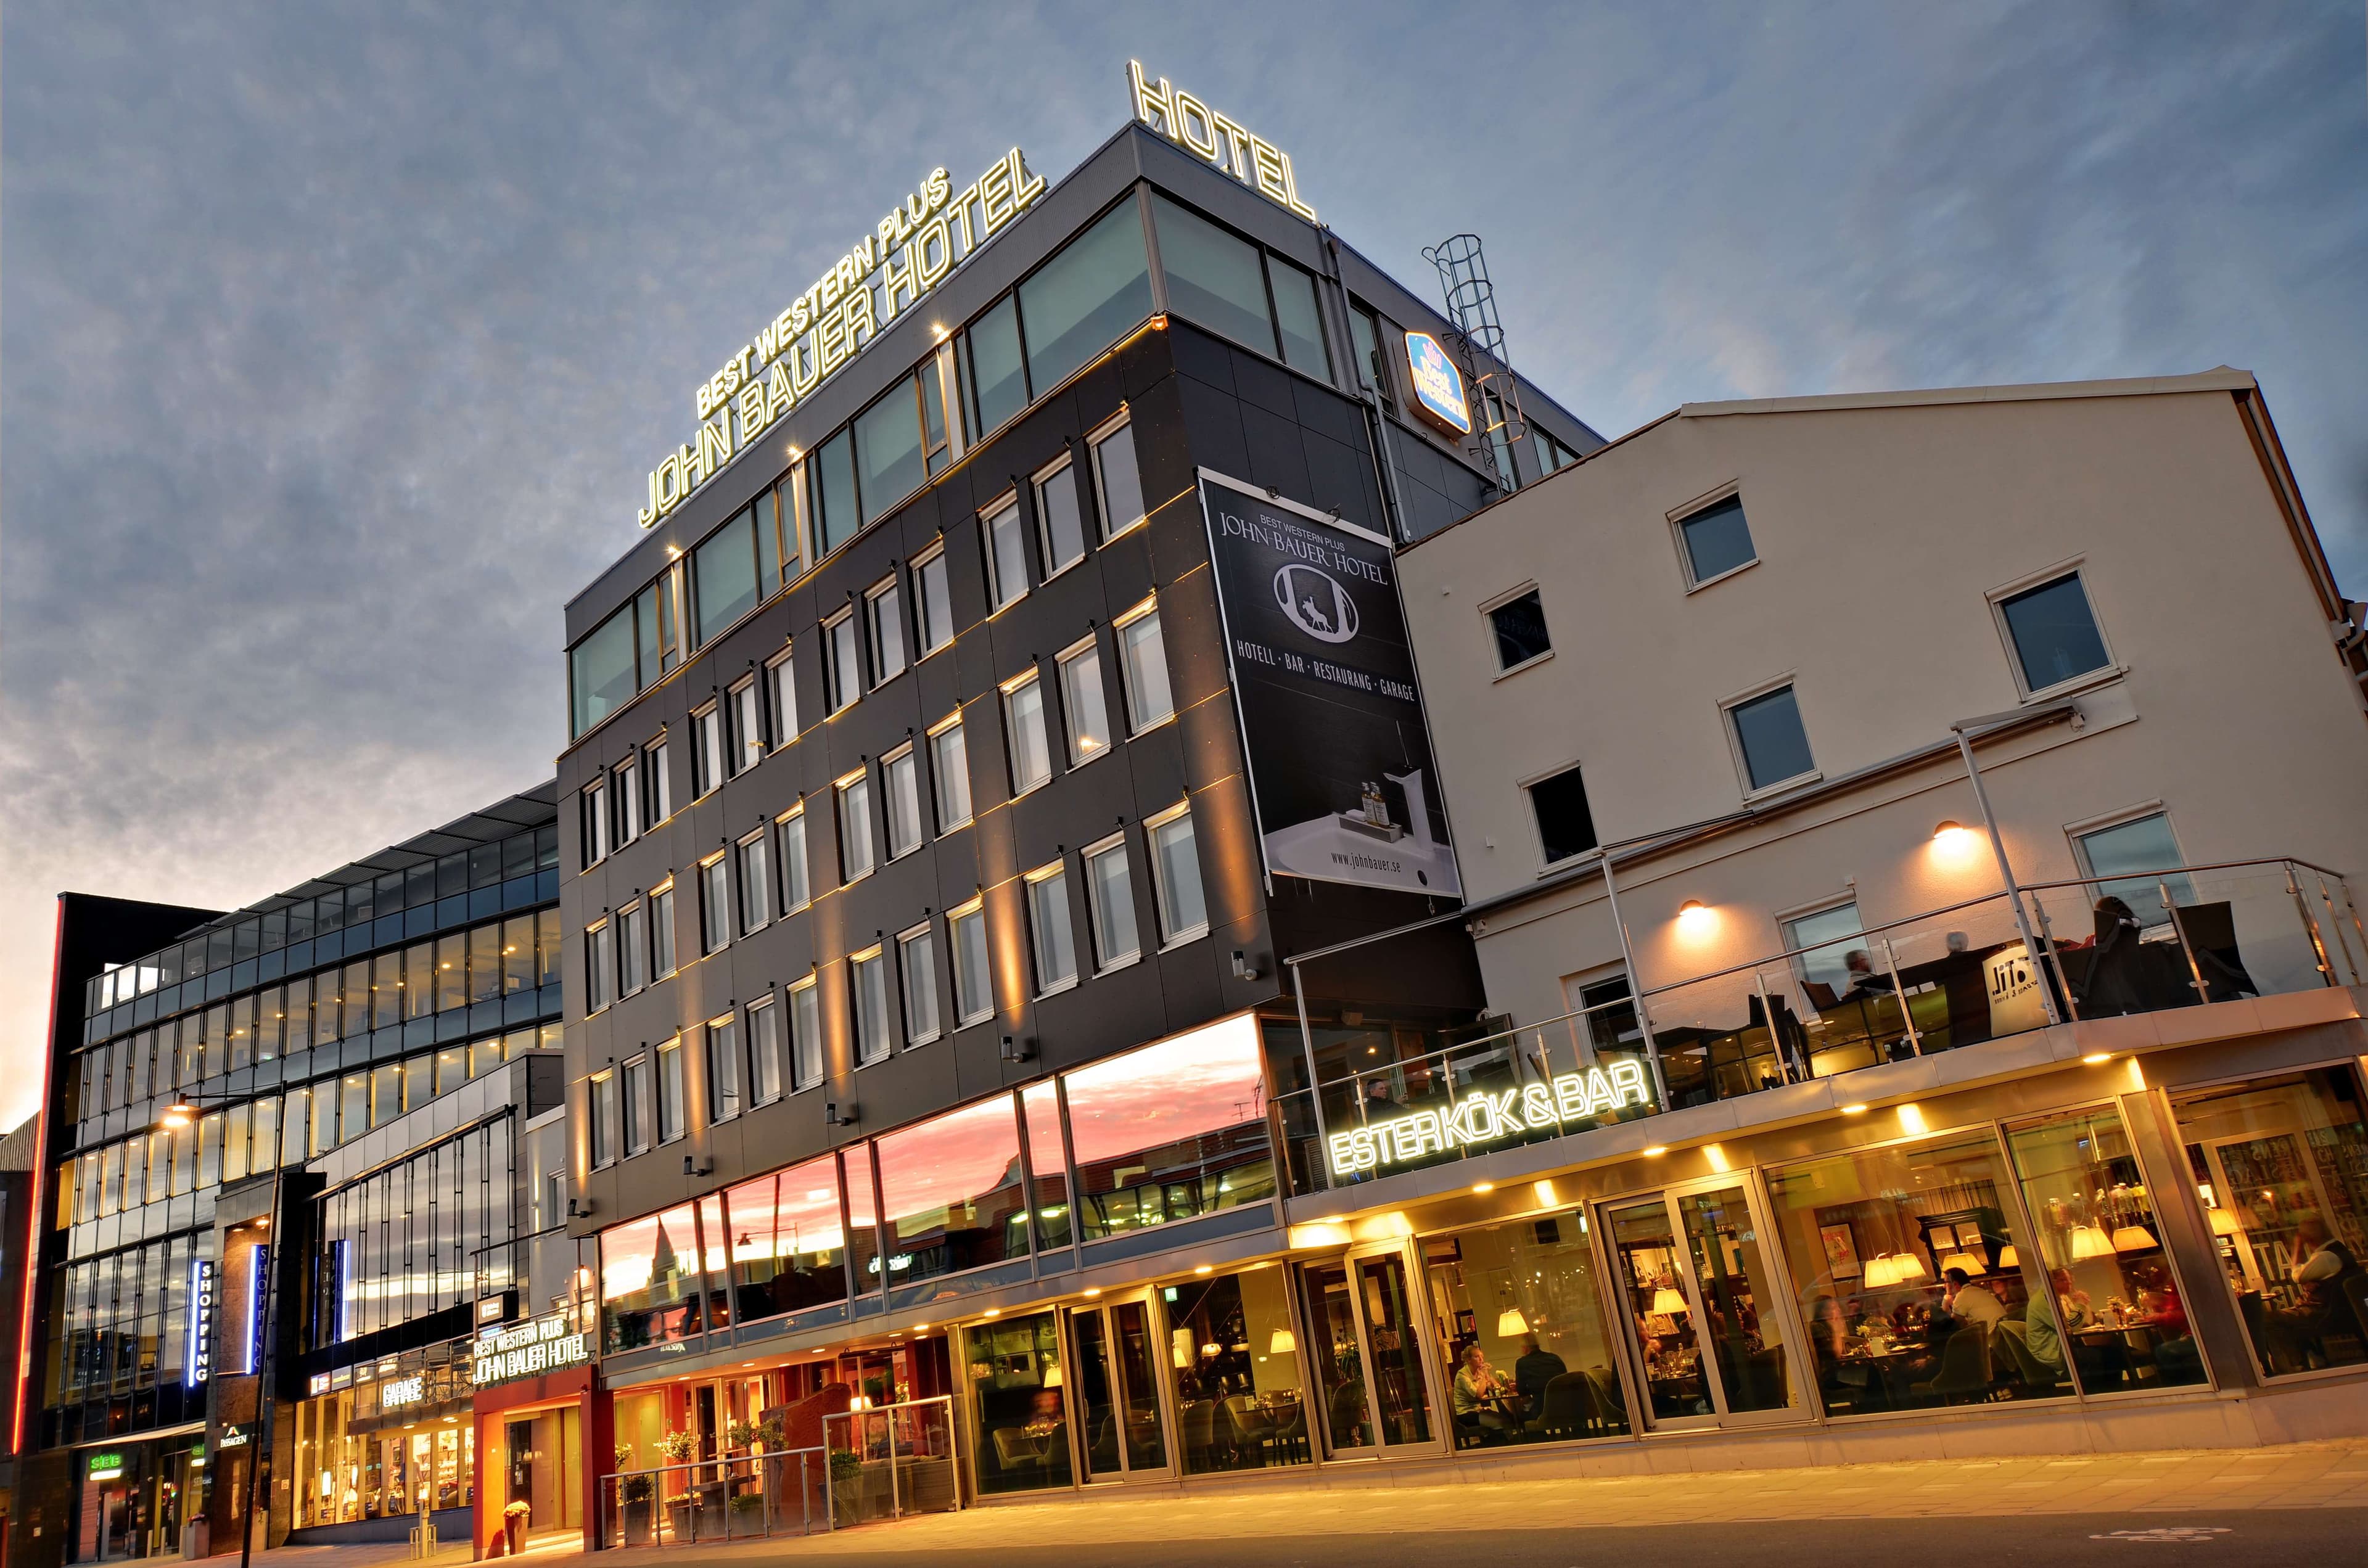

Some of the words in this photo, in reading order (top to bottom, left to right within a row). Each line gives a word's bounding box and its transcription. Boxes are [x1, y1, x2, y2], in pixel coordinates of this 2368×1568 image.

[1126, 59, 1316, 223] HOTEL
[696, 344, 755, 421] BEST
[755, 234, 878, 364] WESTERN
[878, 166, 953, 257] PLUS
[638, 406, 735, 528] JOHN
[739, 282, 876, 444] BAUER
[882, 147, 1047, 319] HOTEL
[1413, 367, 1468, 422] Western
[1420, 356, 1452, 395] Best
[1220, 512, 1270, 546] JOHN
[1272, 531, 1331, 567] BAUER
[1334, 552, 1388, 586] HOTEL
[1260, 514, 1282, 530] BEST
[1283, 523, 1324, 544] WESTERN
[1325, 537, 1346, 552] PLUS
[1236, 639, 1276, 666] HOTELL
[1285, 653, 1305, 673] BAR
[1313, 661, 1372, 691] RESTAURANG
[1379, 679, 1415, 701] GARAGE
[1331, 852, 1401, 873] www.johnbauer.se
[1328, 1110, 1443, 1175] ESTER
[1441, 1090, 1526, 1149] KÖK
[1521, 1082, 1559, 1128] &
[1552, 1059, 1649, 1122] BAR
[195, 1265, 212, 1382] SHOPPING
[474, 1336, 495, 1359] BEST
[496, 1324, 538, 1352] WESTERN
[539, 1318, 564, 1341] PLUS
[472, 1355, 506, 1385] JOHN
[507, 1344, 547, 1377] BAUER
[548, 1332, 588, 1367] HOTEL
[383, 1376, 422, 1408] GARAGE
[220, 1434, 248, 1448] PASSAGEN
